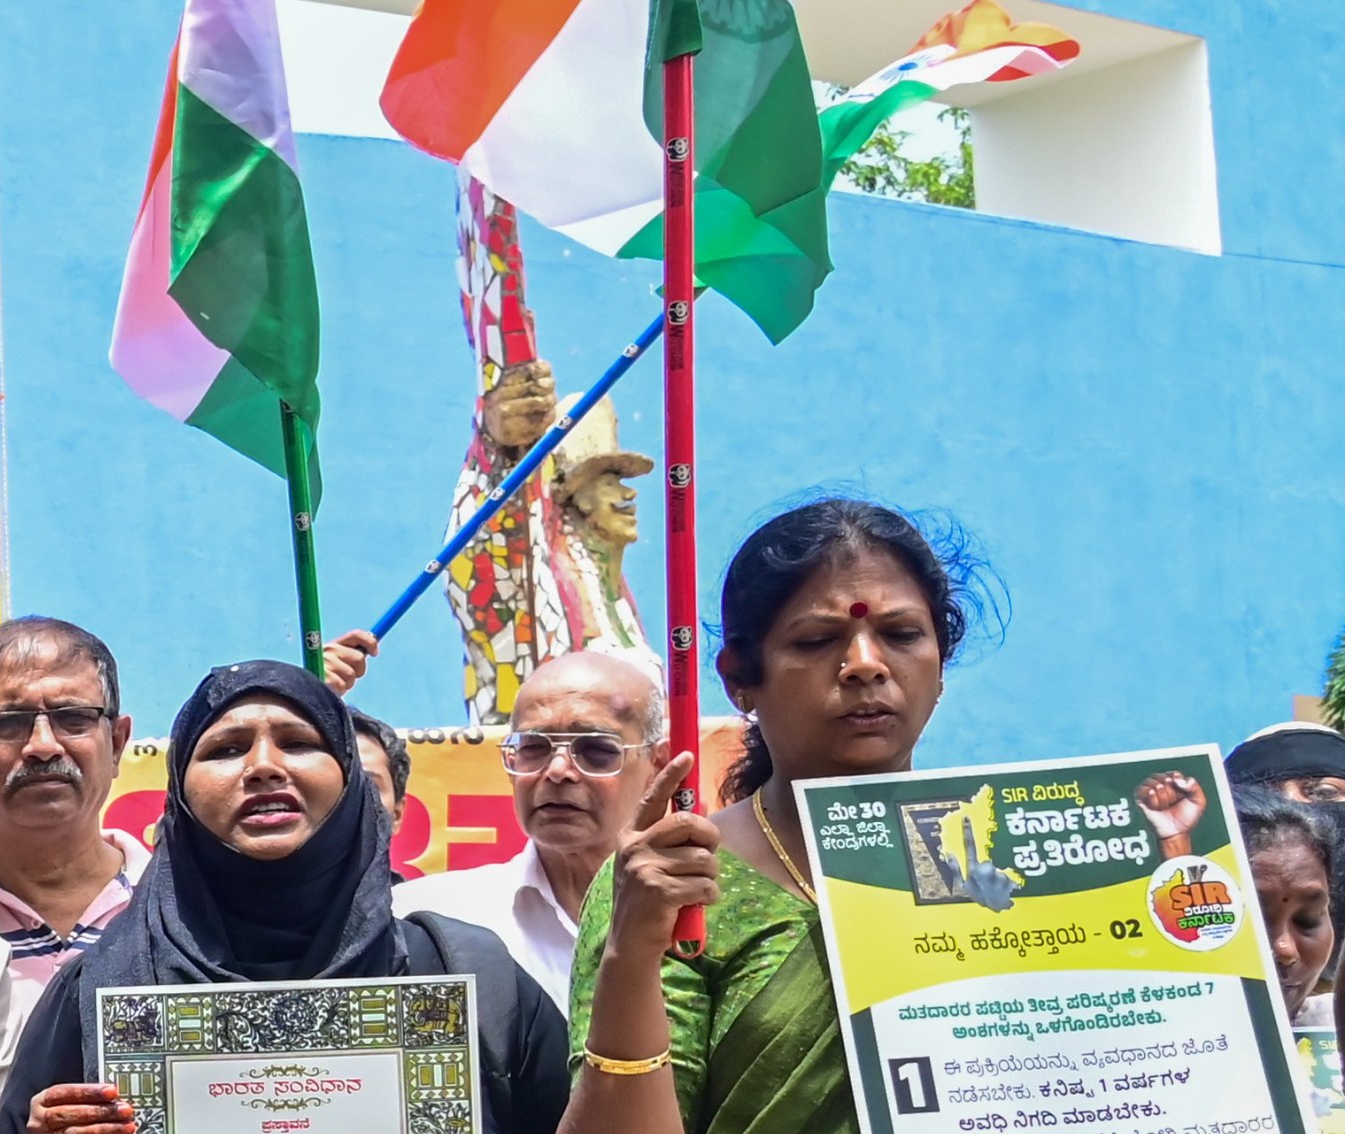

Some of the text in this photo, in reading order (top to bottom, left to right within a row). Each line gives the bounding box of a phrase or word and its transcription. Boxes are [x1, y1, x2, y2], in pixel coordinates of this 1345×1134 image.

[1000, 786, 1029, 804] SIR
[826, 800, 886, 821] ಮೇ 30
[1003, 798, 1131, 836] ಕರ್ನಾಟಕ
[1011, 829, 1151, 877] ಪ್ರತಿರೋಧ
[1169, 881, 1232, 912] SIR
[1178, 911, 1237, 930] ಕರ್ನಾಟಕ
[206, 1076, 362, 1098] ಭಾರತ ಸಂವಿಧಾನ
[897, 1060, 928, 1110] 1
